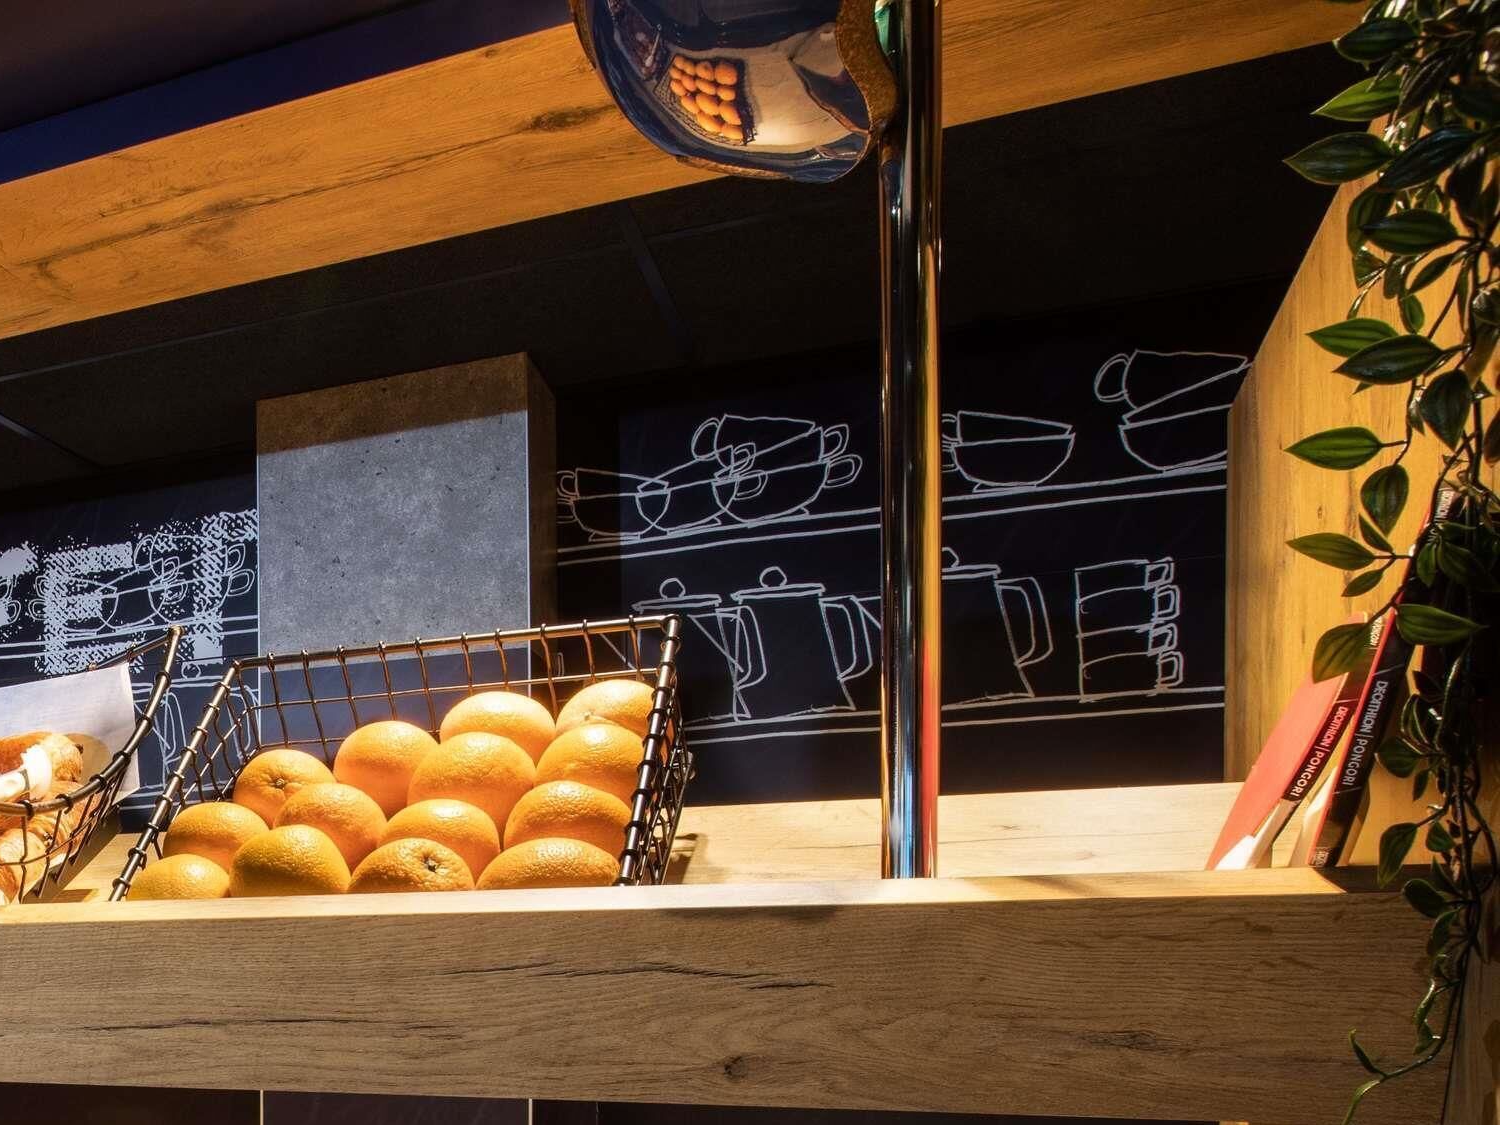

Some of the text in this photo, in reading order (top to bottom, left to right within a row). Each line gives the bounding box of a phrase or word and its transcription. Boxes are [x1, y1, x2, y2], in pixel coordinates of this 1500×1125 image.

[1360, 680, 1389, 733] DECATHLON
[1290, 706, 1349, 797] DECATHLON PONGORI
[1342, 738, 1370, 786] PONGORI
